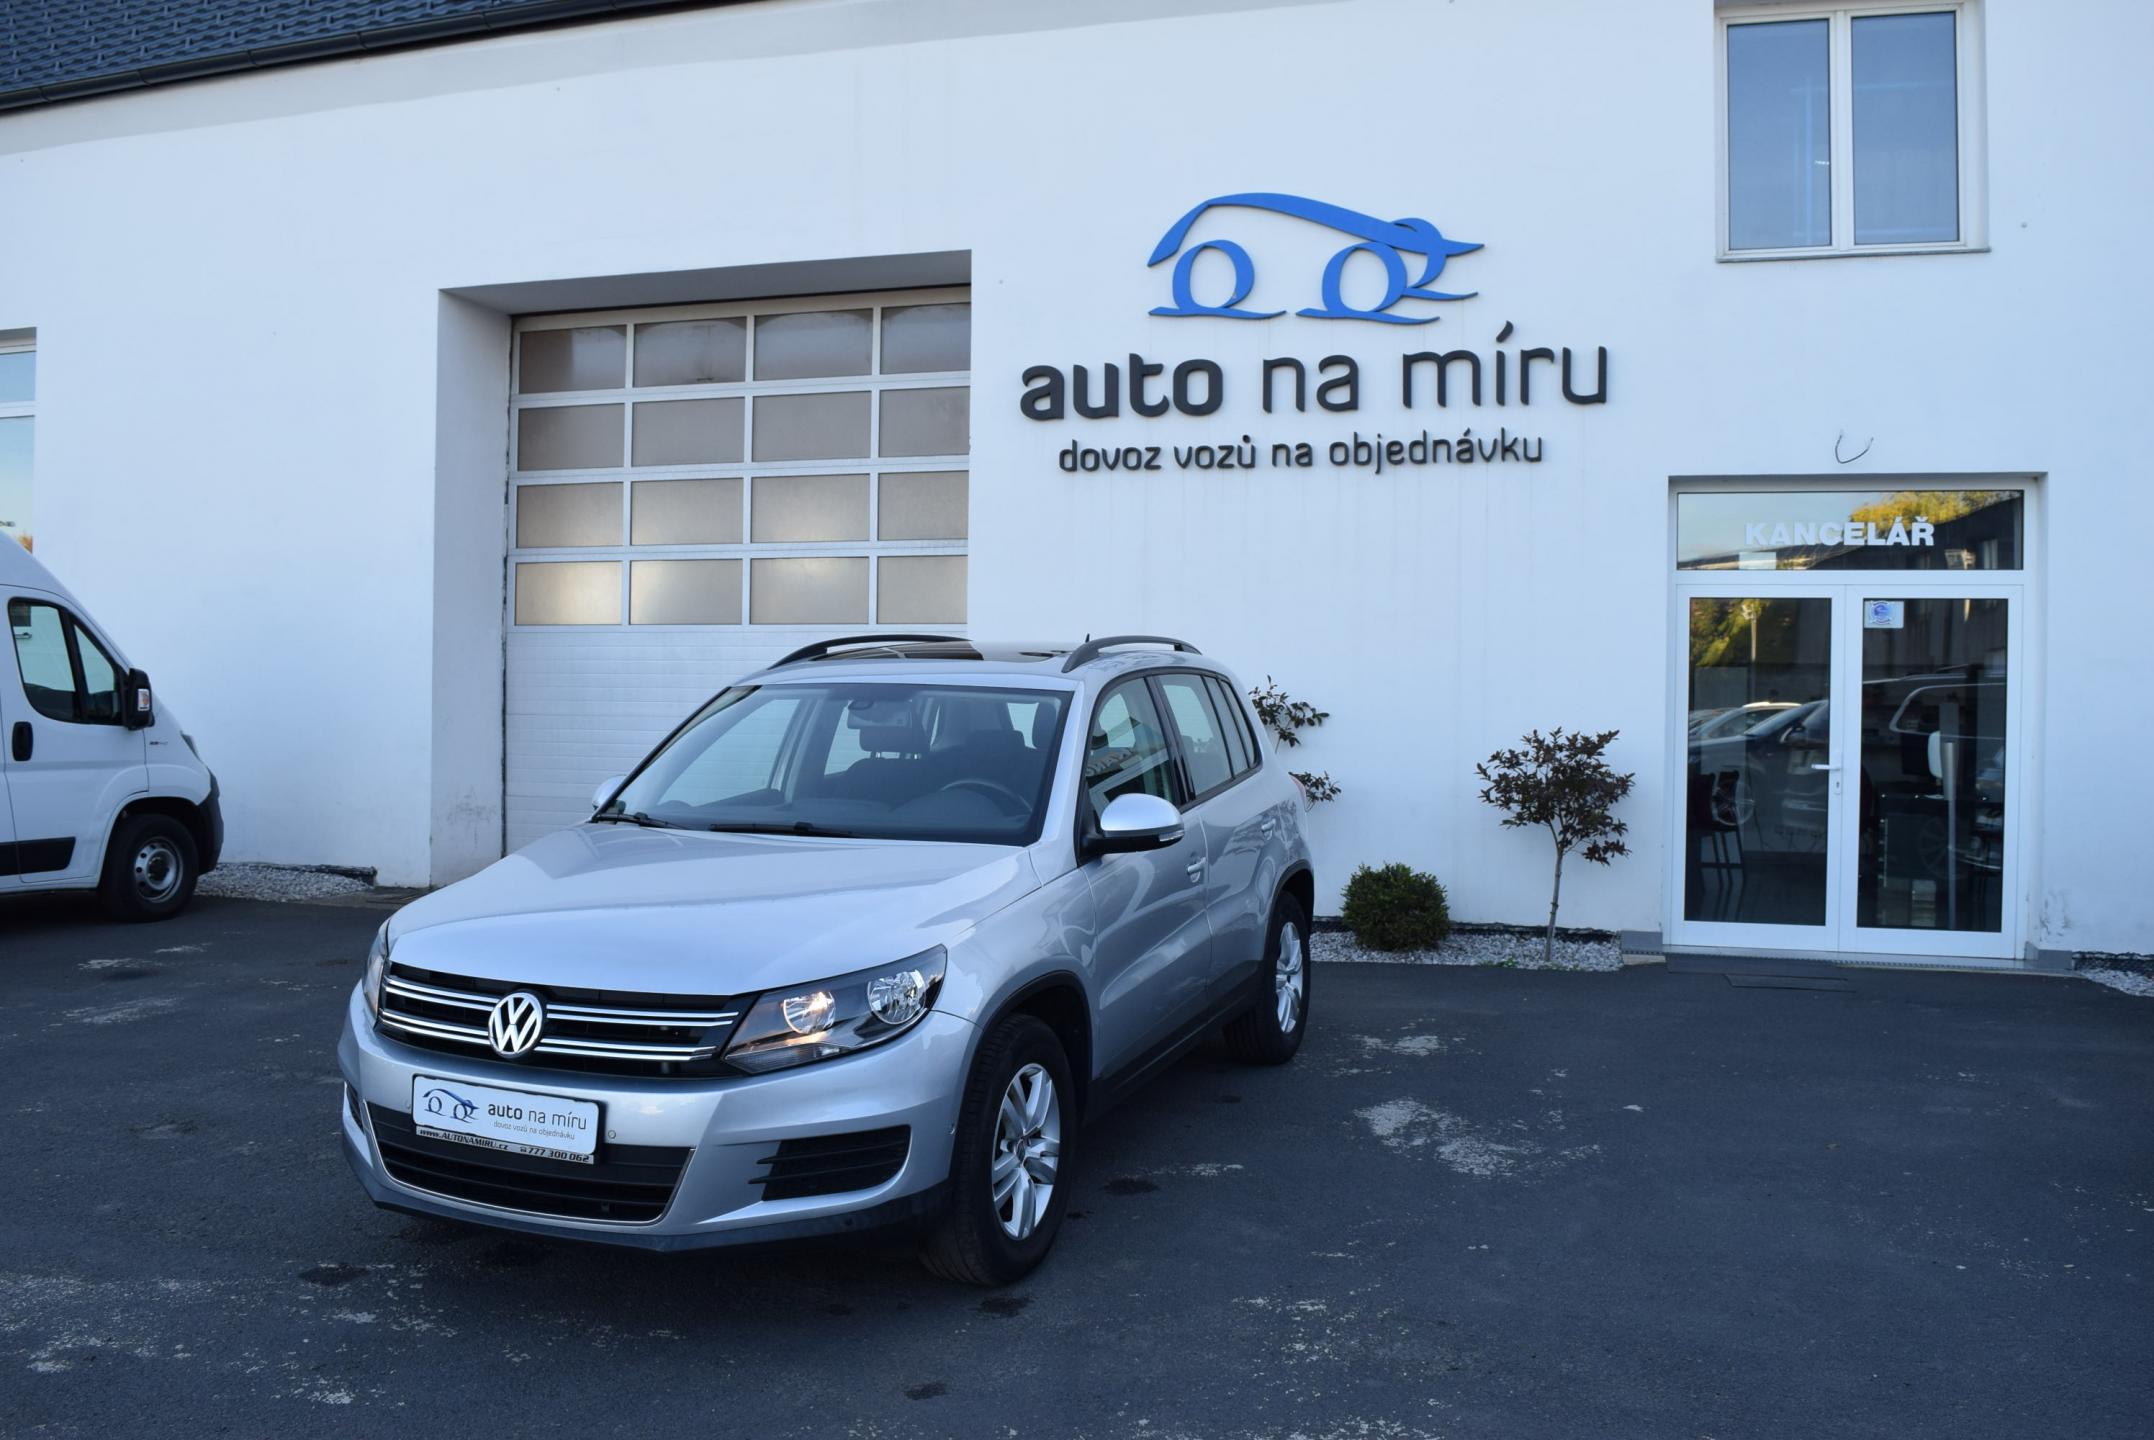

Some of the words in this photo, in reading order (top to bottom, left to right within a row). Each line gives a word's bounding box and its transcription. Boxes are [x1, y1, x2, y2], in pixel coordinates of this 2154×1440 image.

[1020, 353, 1224, 422] auto
[1262, 354, 1359, 414] na
[1401, 320, 1608, 409] míru
[1059, 439, 1162, 473] dovoz
[1173, 434, 1256, 470] vozů
[1271, 442, 1313, 468] na
[1329, 427, 1543, 475] objednávku
[1744, 515, 1935, 547] KANCELÁŘ
[487, 1103, 523, 1120] auto
[528, 1110, 546, 1124] na
[551, 1111, 587, 1130] míru
[493, 1120, 512, 1130] dovoz
[529, 1126, 538, 1134] na
[568, 1153, 590, 1163] 062
